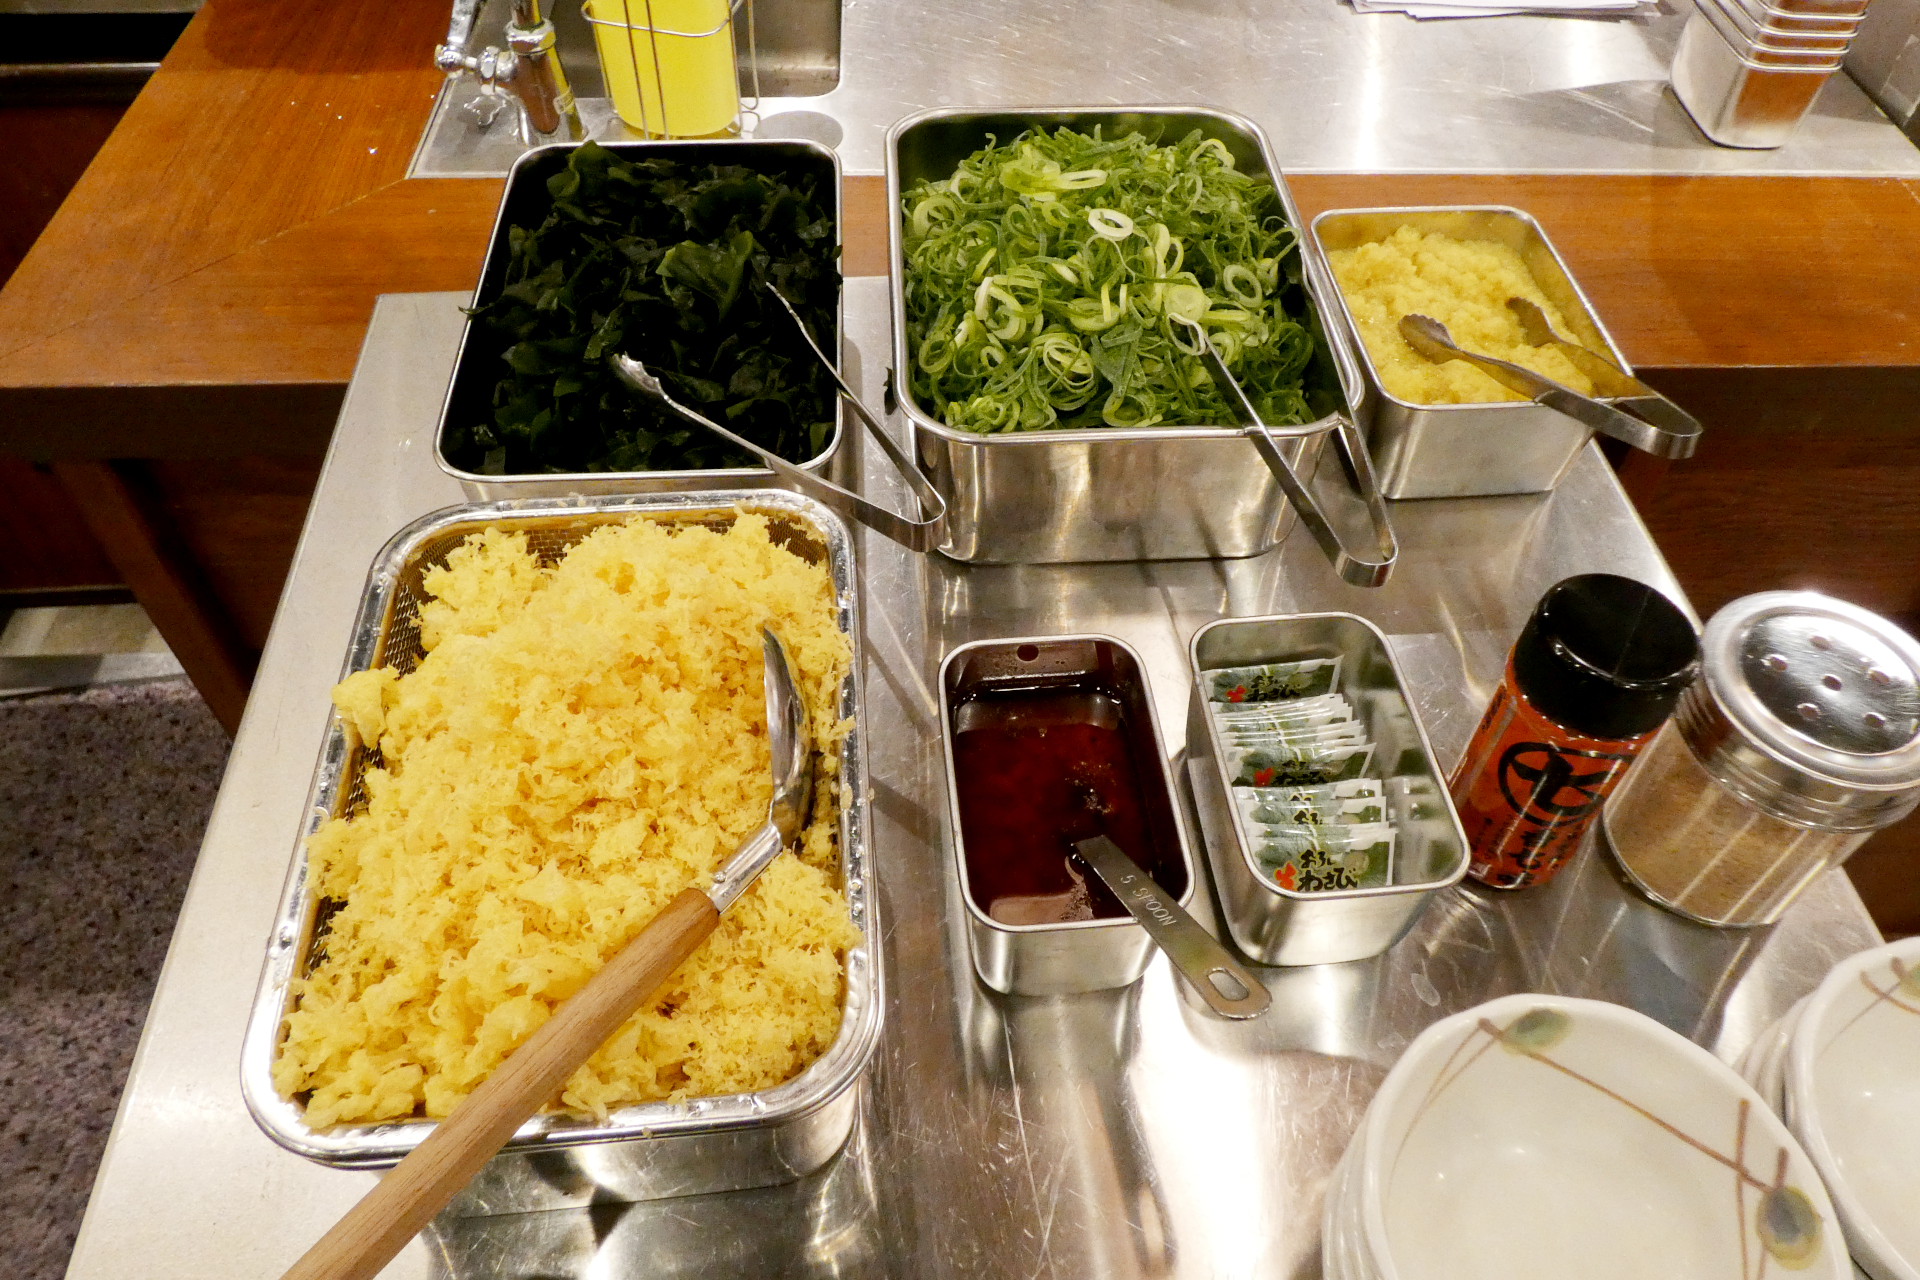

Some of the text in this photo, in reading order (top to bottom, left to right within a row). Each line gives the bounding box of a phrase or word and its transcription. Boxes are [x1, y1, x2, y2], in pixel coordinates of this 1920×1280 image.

[1300, 849, 1335, 869] おろし
[1297, 867, 1358, 892] わさび
[1120, 874, 1177, 926] 5 SPOON
